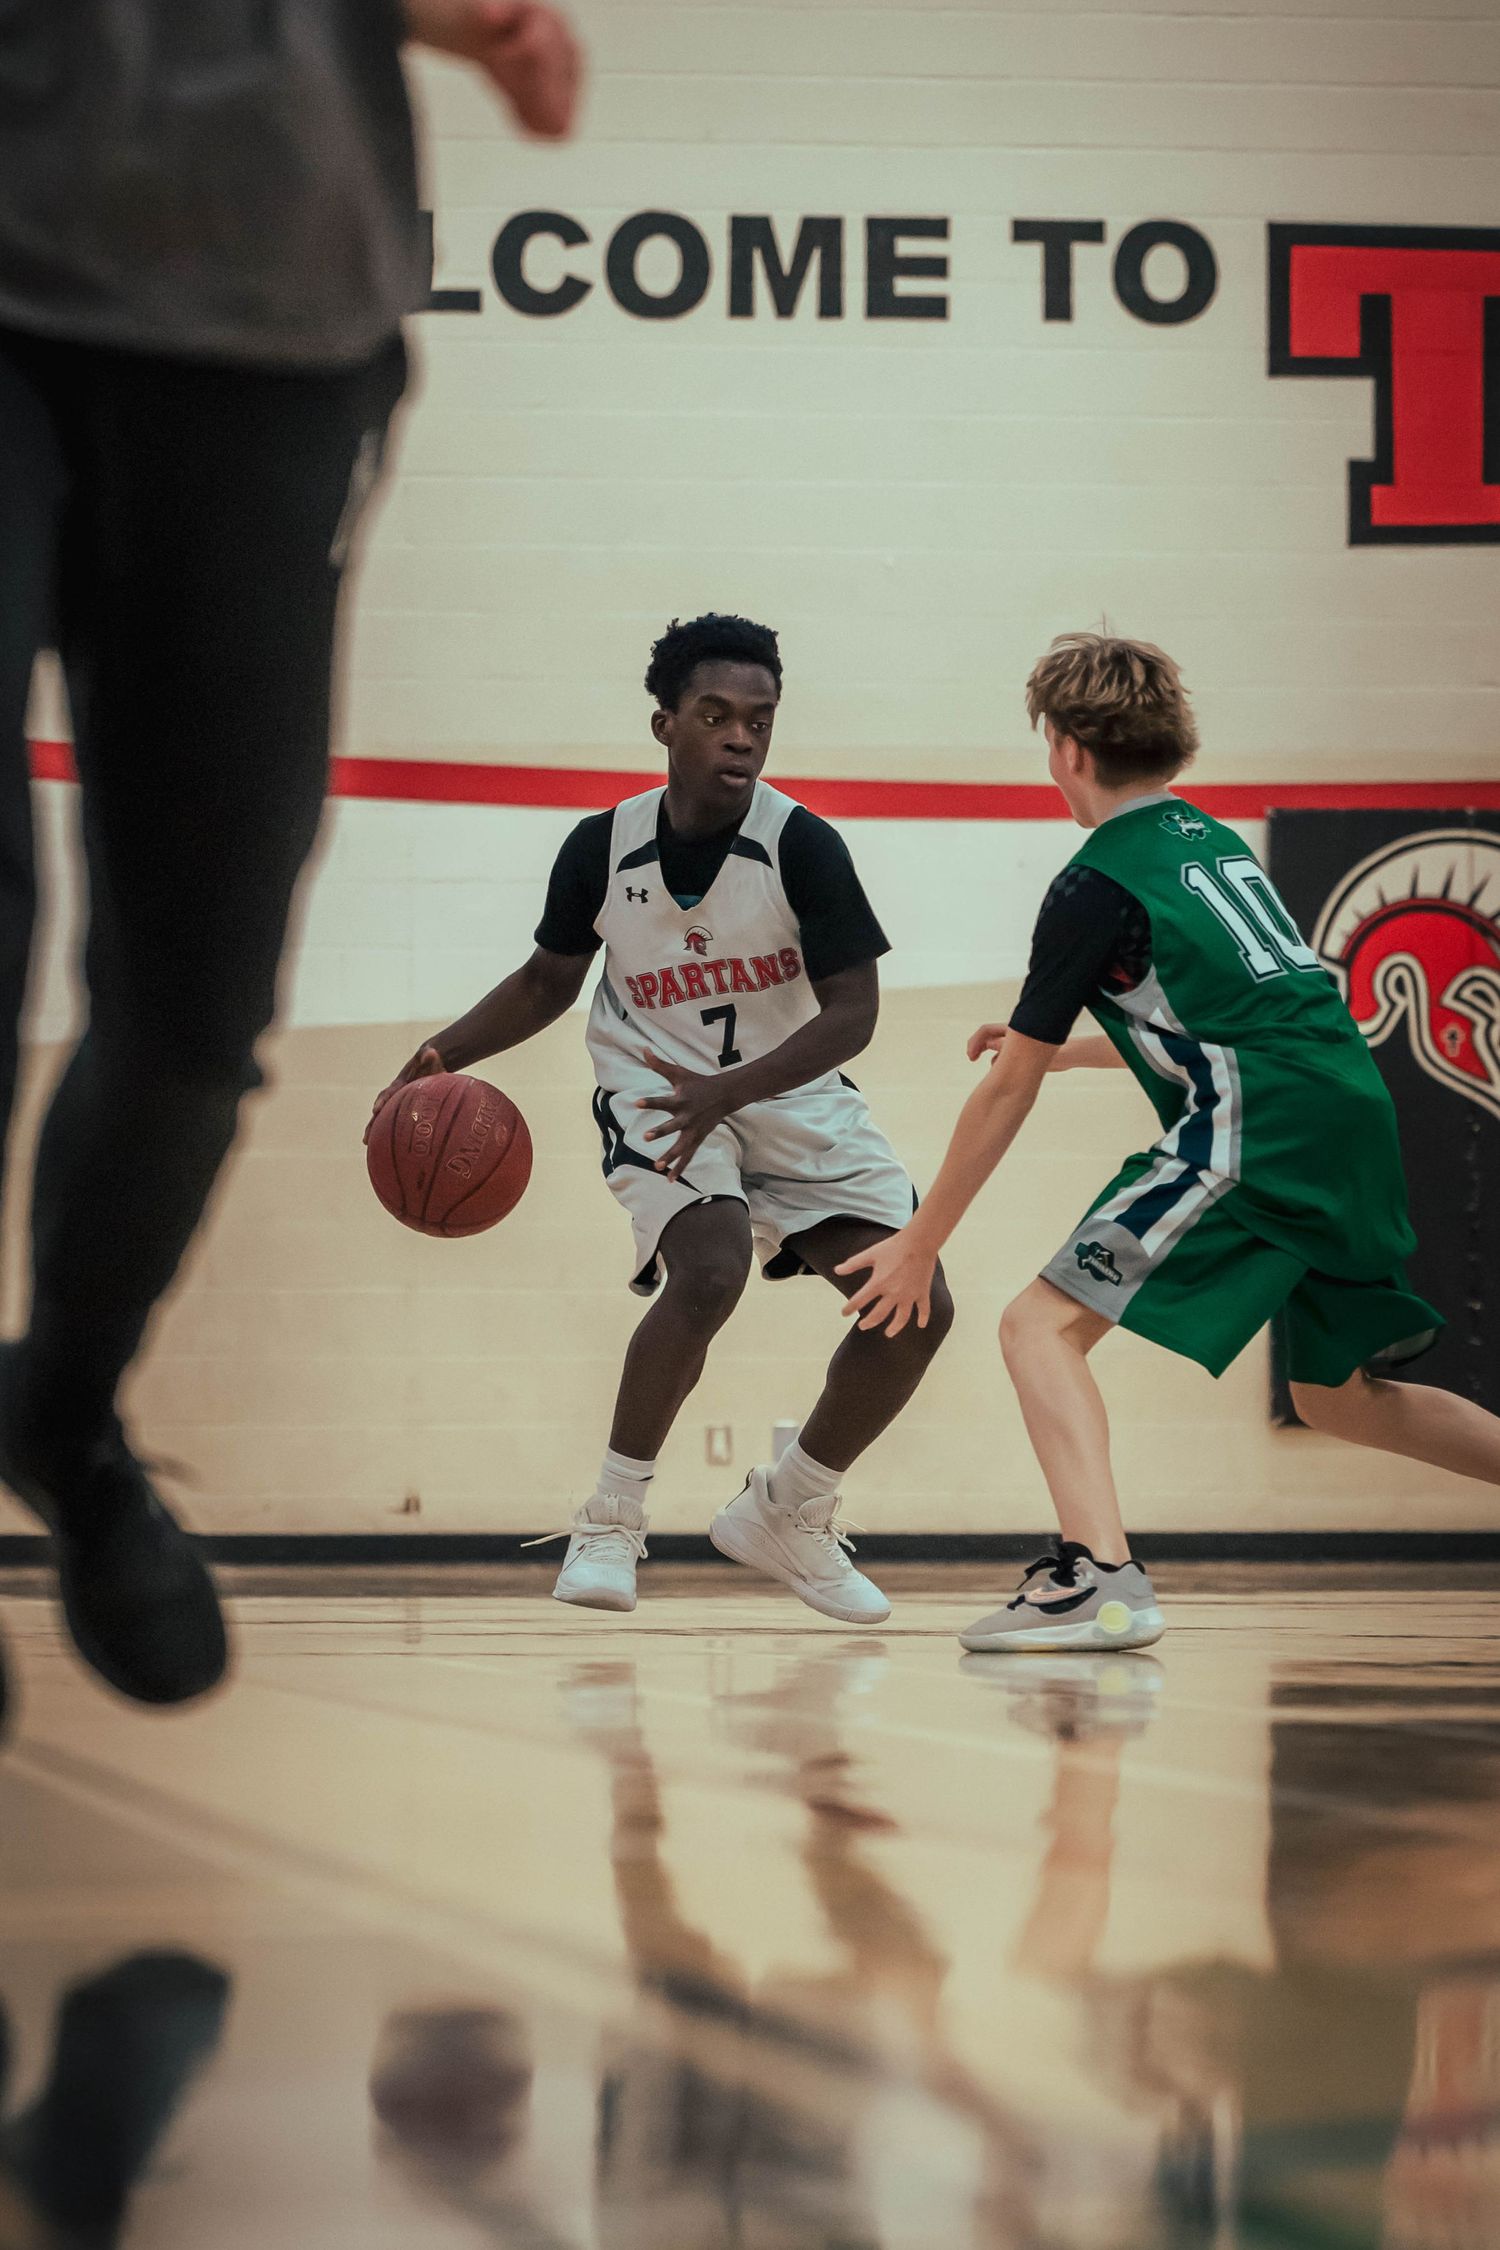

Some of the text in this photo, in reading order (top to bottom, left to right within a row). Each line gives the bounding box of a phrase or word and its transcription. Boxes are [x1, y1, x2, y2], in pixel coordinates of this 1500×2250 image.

[1012, 220, 1219, 326] TO
[1267, 223, 1500, 546] T
[1181, 854, 1325, 983] 10
[624, 948, 802, 1009] SPARTANS
[700, 1003, 743, 1068] 7
